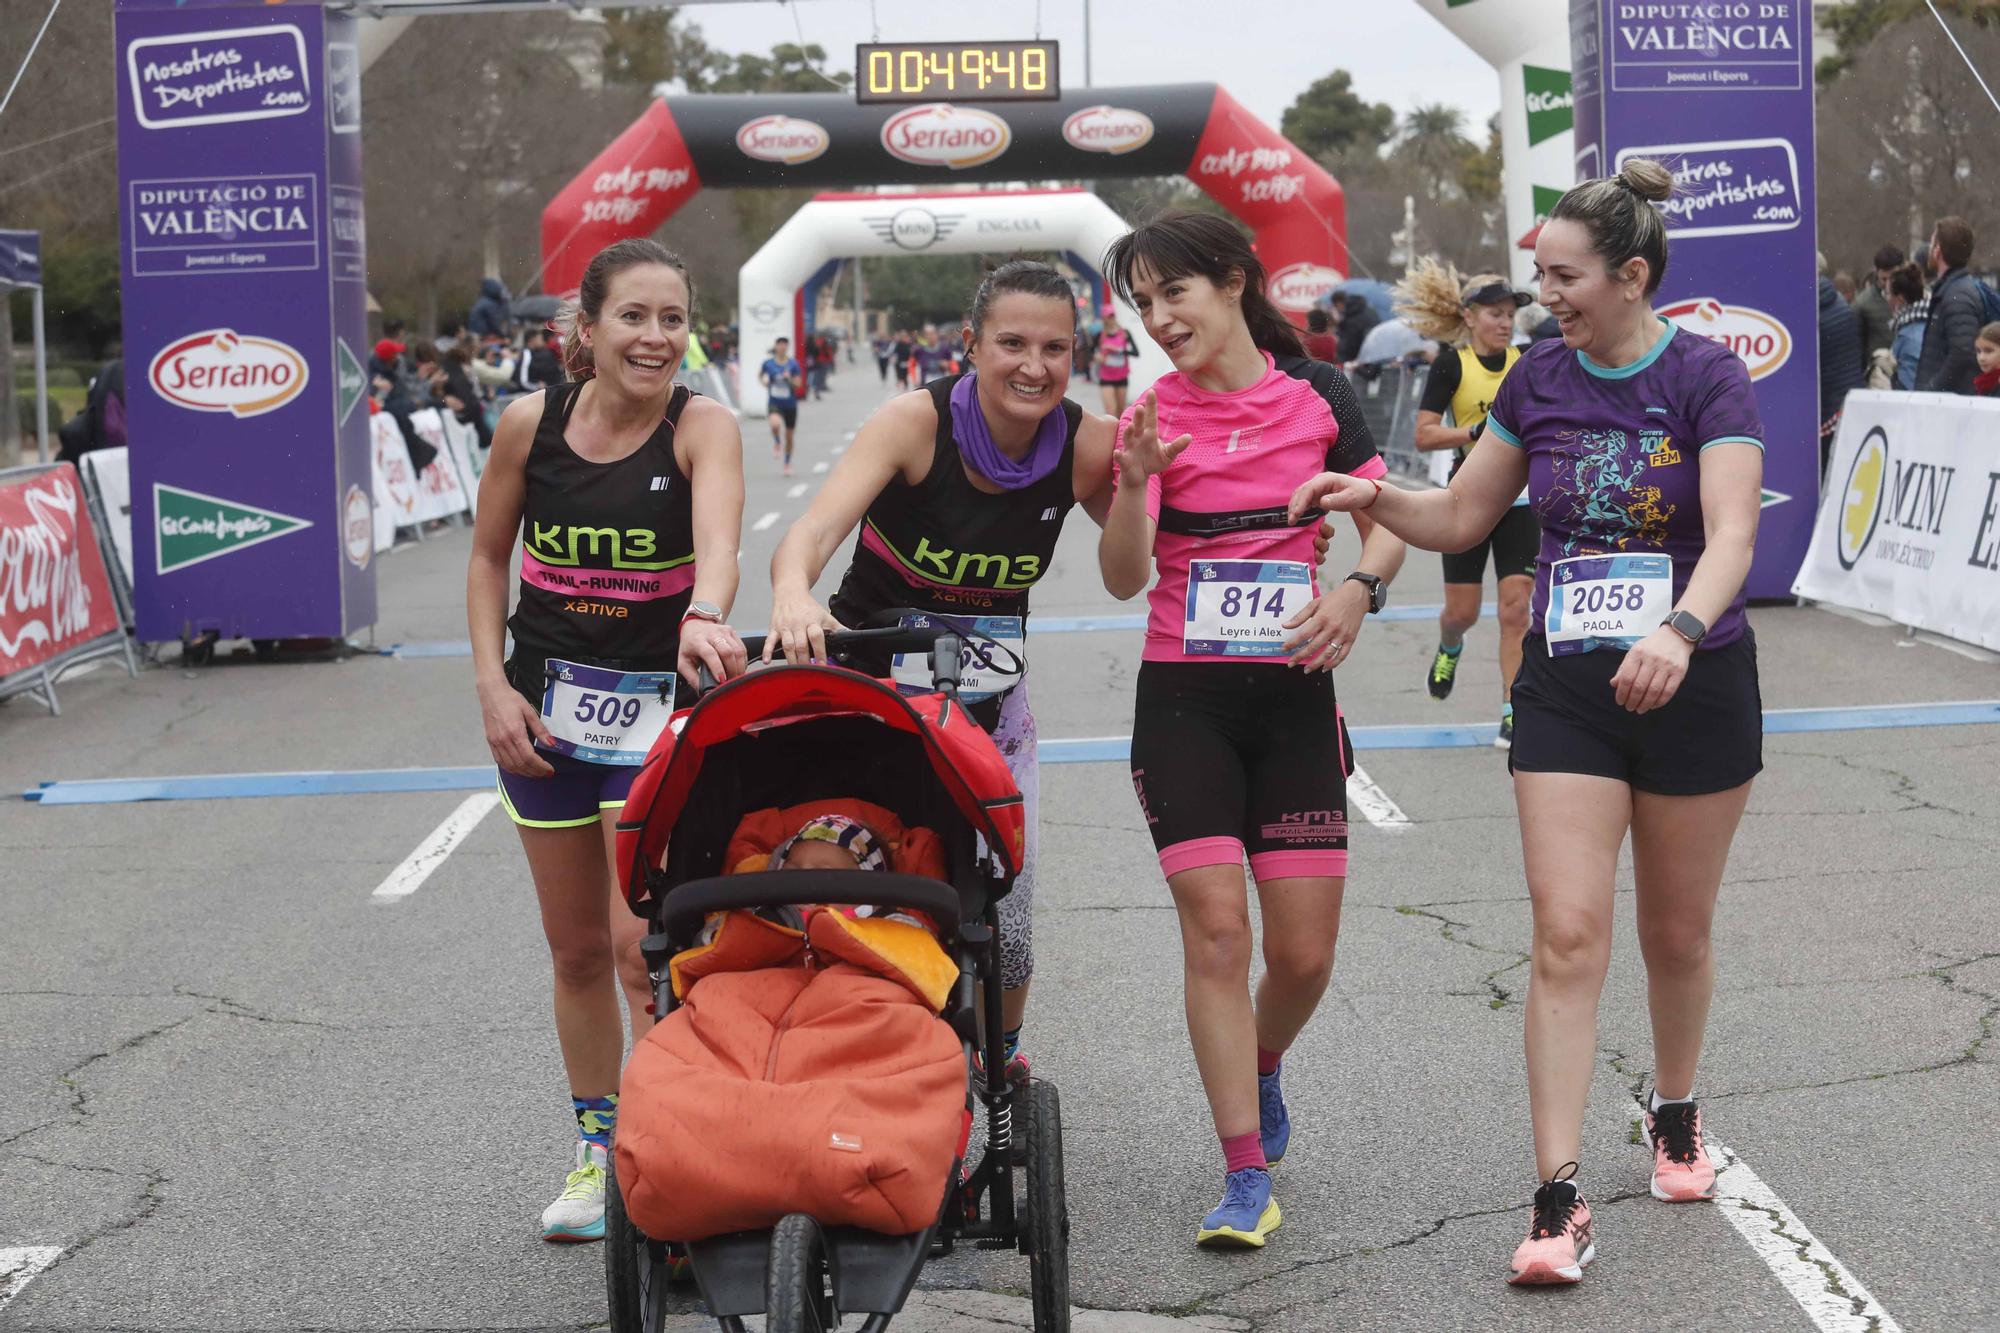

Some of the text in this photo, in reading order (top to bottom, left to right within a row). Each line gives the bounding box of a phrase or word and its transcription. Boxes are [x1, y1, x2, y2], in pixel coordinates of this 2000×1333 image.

[1620, 3, 1789, 19] DIPUTACIÓ DE
[1619, 20, 1792, 50] VALÈNCIA
[868, 48, 1047, 93] 00:49:48
[153, 61, 295, 108] Deportistas
[749, 130, 818, 149] Serrano
[900, 124, 997, 152] Serrano
[1075, 123, 1144, 140] Serrano
[140, 185, 306, 205] DIPUTACIÓ DE
[140, 205, 309, 235] VALÈNCIA
[1753, 205, 1795, 219] .com
[169, 356, 291, 389] Serrano
[1638, 436, 1672, 454] 10K
[1652, 451, 1679, 465] FEM
[1884, 459, 1955, 535] MINI
[539, 570, 661, 593] TRAIL-RUNNING
[1220, 586, 1285, 618] 814
[1572, 584, 1645, 615] 2058
[1220, 626, 1250, 638] Leyre
[1259, 627, 1282, 637] Alex
[1583, 620, 1624, 631] PAOLA
[574, 692, 641, 728] 509
[584, 733, 621, 745] PATRY
[1274, 827, 1345, 835] TRAIL-RUNNING
